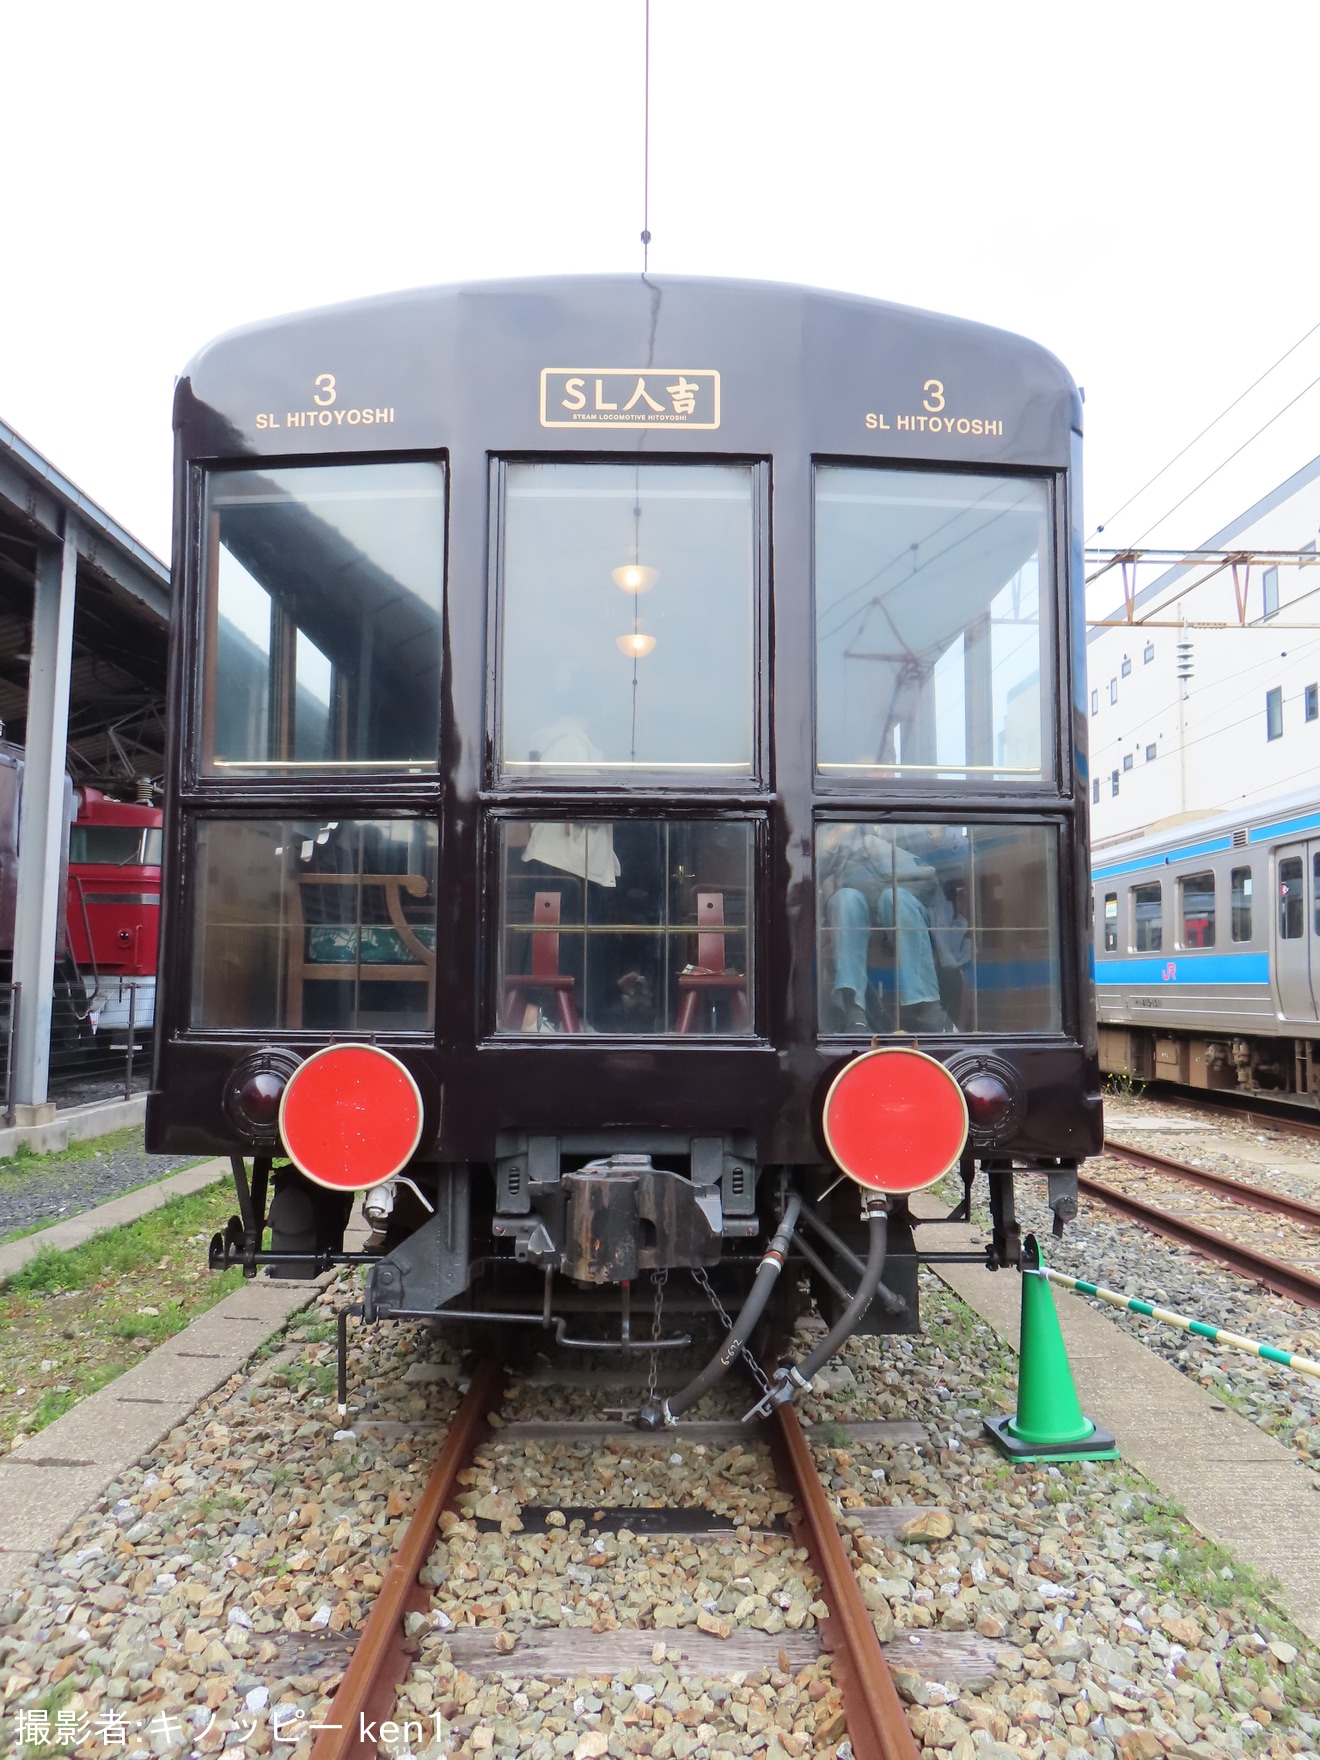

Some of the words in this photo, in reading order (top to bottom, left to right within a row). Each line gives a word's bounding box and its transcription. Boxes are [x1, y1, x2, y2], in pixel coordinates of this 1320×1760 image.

[313, 373, 337, 407] 3
[561, 376, 700, 415] SL人吉
[922, 379, 946, 413] 3
[255, 413, 281, 429] SL
[286, 407, 395, 428] HITOYOSHI
[865, 413, 891, 430] SL
[897, 414, 1003, 436] HITOYOSHI
[1161, 961, 1176, 981] JR
